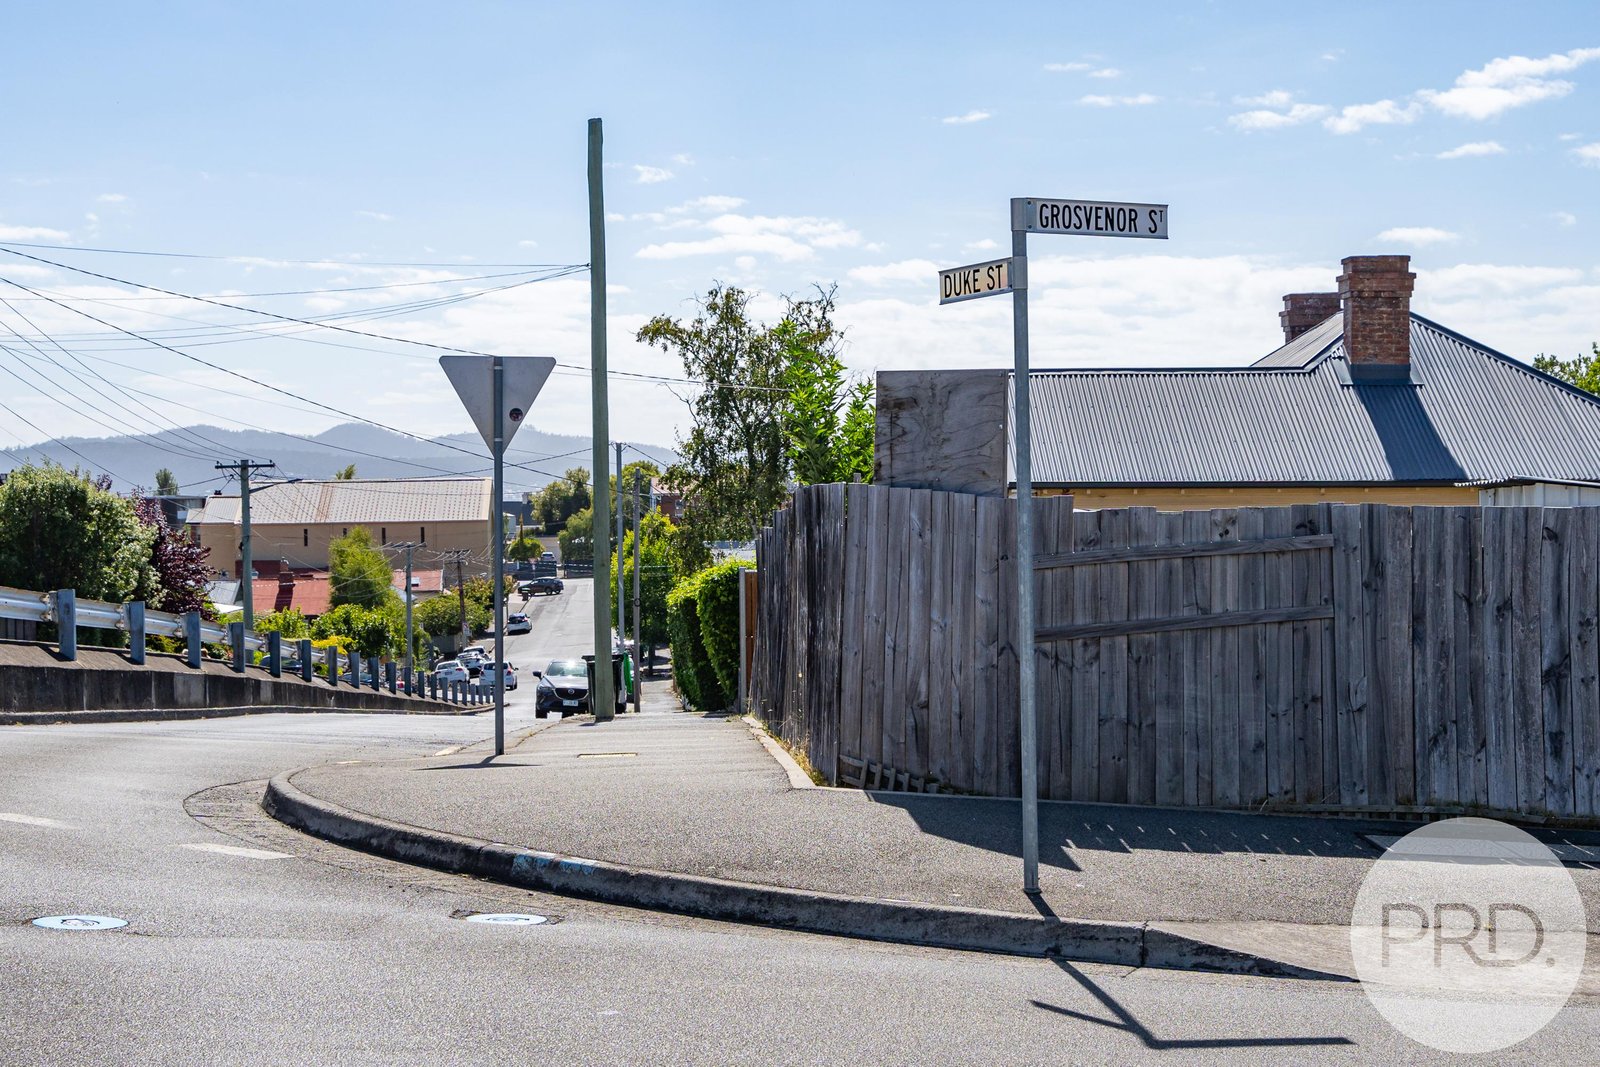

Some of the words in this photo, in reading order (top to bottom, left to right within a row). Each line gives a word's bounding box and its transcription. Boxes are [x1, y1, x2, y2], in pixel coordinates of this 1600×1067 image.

[1039, 203, 1138, 233] GROSVENOR
[1148, 209, 1164, 234] ST
[944, 268, 981, 298] DUKE
[986, 264, 1003, 290] ST
